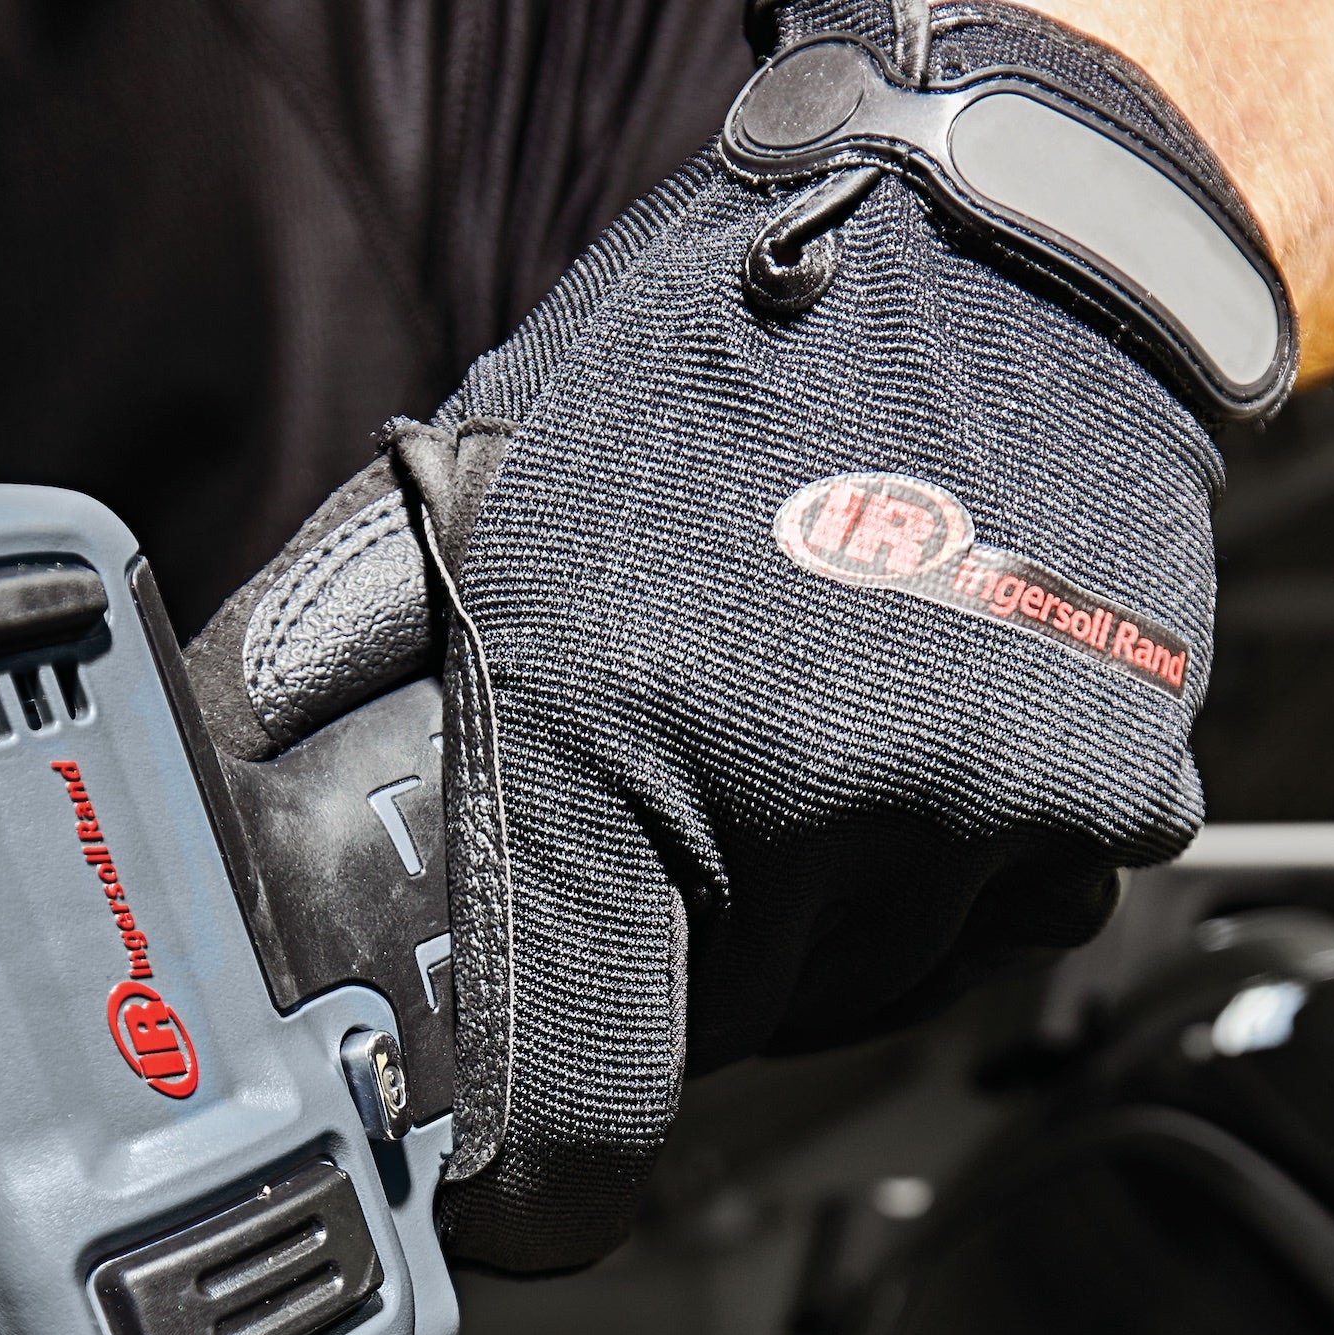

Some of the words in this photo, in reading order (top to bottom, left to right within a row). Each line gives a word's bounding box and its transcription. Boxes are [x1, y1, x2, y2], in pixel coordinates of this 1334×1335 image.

[805, 479, 937, 576] IR
[952, 553, 1114, 652] Ingersoll
[1111, 620, 1187, 688] Rand
[51, 761, 104, 842] Rand
[82, 846, 153, 979] Ingersoll
[122, 998, 189, 1081] IR
